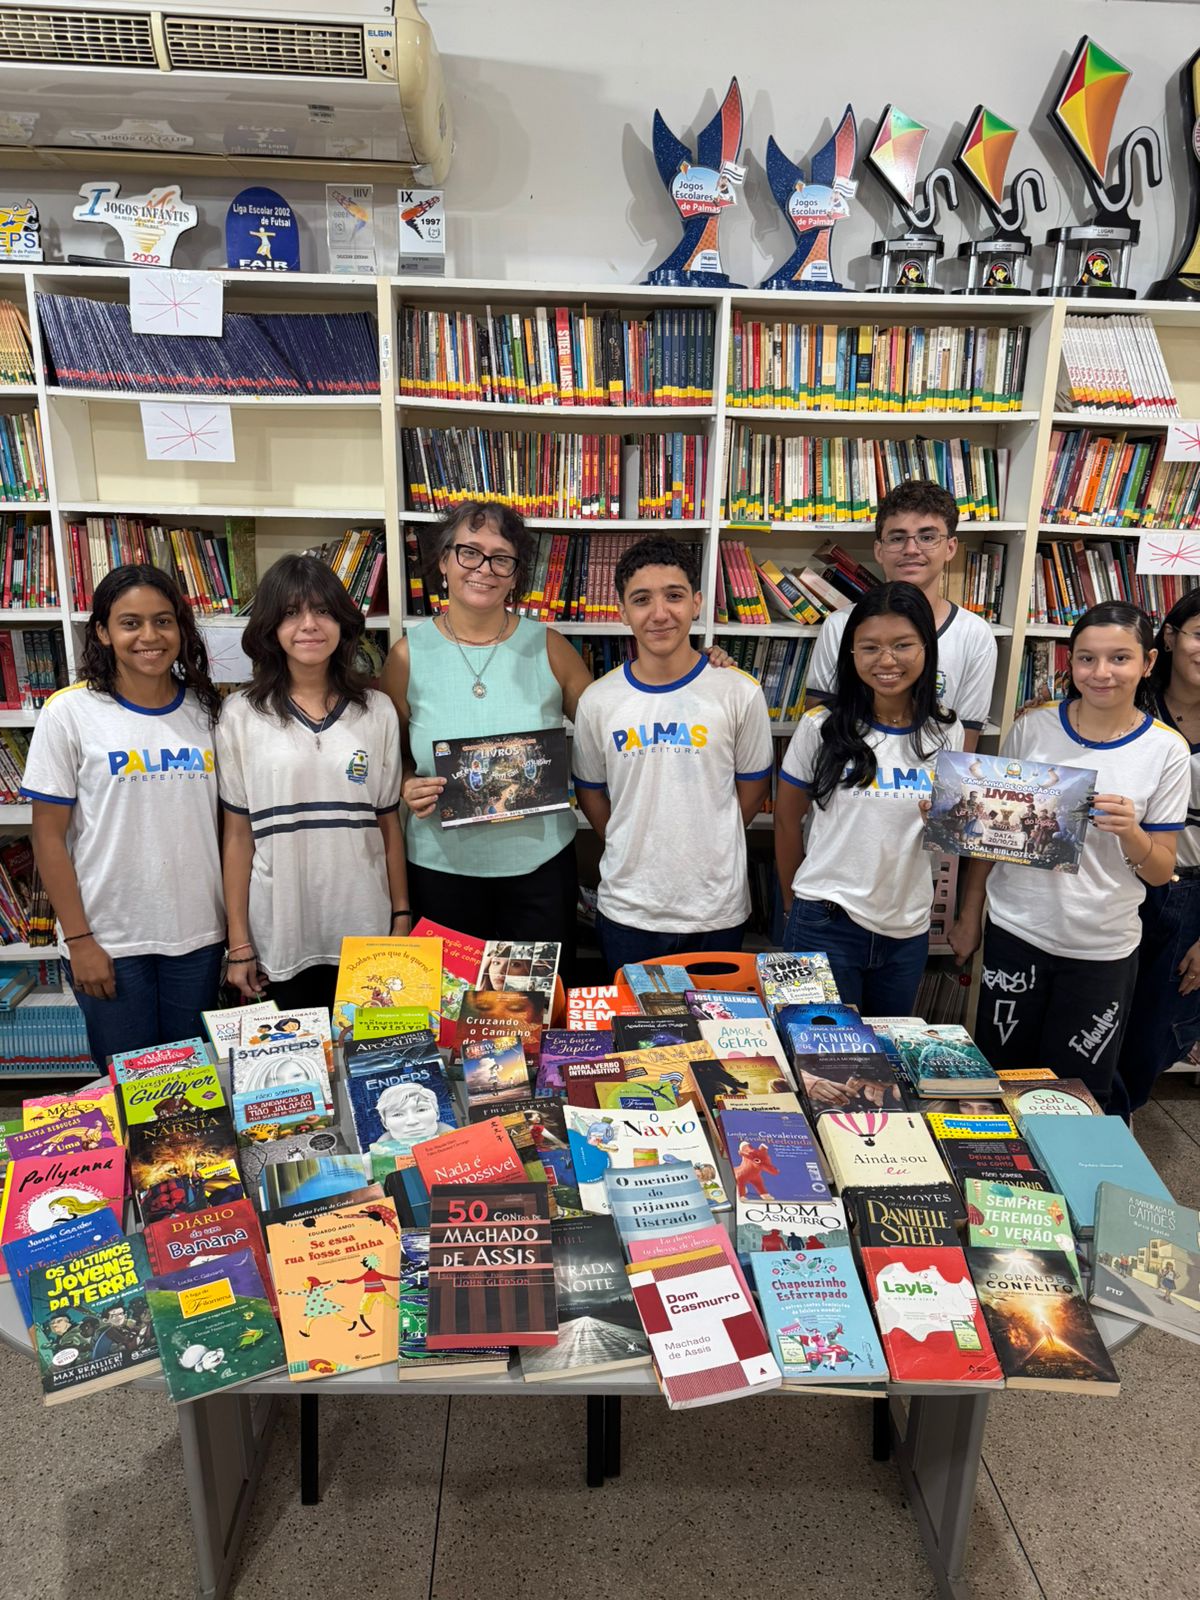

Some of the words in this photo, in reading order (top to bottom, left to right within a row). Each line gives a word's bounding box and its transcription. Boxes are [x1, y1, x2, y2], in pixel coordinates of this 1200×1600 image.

[368, 30, 392, 38] ELGIN
[679, 181, 704, 191] Jogos
[401, 191, 413, 203] IX
[675, 192, 713, 202] Escolares
[795, 199, 818, 209] Jogos
[104, 201, 139, 216] JOGOS
[141, 206, 190, 223] INFANTIS
[233, 204, 247, 215] Liga
[248, 206, 273, 216] Escolar
[274, 207, 291, 217] 2002
[680, 203, 691, 211] de
[692, 203, 721, 213] Palmas
[791, 208, 827, 216] Escolares
[261, 217, 270, 226] de
[270, 217, 291, 228] Futsal
[798, 218, 807, 226] de
[808, 218, 834, 227] Palmas
[132, 252, 161, 264] 2002
[239, 259, 288, 268] FAIR
[557, 330, 570, 356] STIEG
[612, 722, 709, 752] PALMAS
[481, 746, 520, 758] LIVROS
[108, 748, 214, 775] PALMAS
[962, 777, 1004, 788] CAMPANHA
[1005, 782, 1015, 790] DE
[1015, 784, 1048, 795] DOAÇÃO
[1049, 788, 1061, 796] DE
[985, 788, 1034, 804] LIVROS
[993, 832, 1015, 840] DATA:
[963, 843, 991, 853] LOCAL:
[993, 848, 1040, 860] BIBLIOTECA
[426, 929, 434, 937] O
[463, 942, 473, 951] de
[388, 950, 402, 959] que
[461, 955, 481, 966] comp
[766, 959, 801, 972] TOM
[772, 966, 813, 983] GATES
[568, 985, 619, 999] #UM
[569, 999, 611, 1010] DIA
[725, 995, 758, 1004] ALENCAR
[466, 1016, 519, 1027] Cruzando
[569, 1009, 616, 1021] SEM
[482, 1027, 531, 1038] Caminho
[569, 1021, 598, 1031] RE
[721, 1026, 755, 1037] AMOR
[356, 1036, 428, 1052] APOCALIPSE
[552, 1036, 566, 1046] Em
[569, 1036, 597, 1045] busca
[718, 1036, 768, 1049] GELATO
[800, 1033, 808, 1043] O
[813, 1032, 861, 1043] MENINO
[238, 1039, 320, 1060] STARTERS
[594, 1061, 620, 1070] VERBO
[928, 1058, 981, 1067] SELEÇÃO
[569, 1067, 621, 1077] INTRANSITIVO
[365, 1069, 431, 1090] ENDERS
[129, 1075, 216, 1106] Gulliver
[272, 1099, 313, 1113] JALAPÃO
[1032, 1094, 1065, 1105] Sob
[1040, 1102, 1061, 1111] céu
[1063, 1102, 1078, 1111] de
[649, 1113, 659, 1123] O
[47, 1118, 81, 1134] REBOUÇAS
[142, 1117, 220, 1140] NÁRNIA
[621, 1119, 696, 1138] Navio
[758, 1130, 809, 1140] Cavaleiros
[766, 1136, 813, 1146] Redonda
[56, 1141, 81, 1152] Uma
[854, 1153, 898, 1164] Ainda
[900, 1155, 928, 1164] sou
[434, 1162, 471, 1181] Nada
[473, 1155, 481, 1169] é
[886, 1166, 911, 1175] eu
[18, 1159, 114, 1193] Pollyanna
[616, 1176, 629, 1187] O
[634, 1173, 689, 1187] menino
[648, 1188, 663, 1198] do
[900, 1193, 952, 1203] MOYES
[632, 1198, 690, 1215] pijama
[765, 1203, 821, 1217] DOM
[986, 1194, 1046, 1212] SEMPRE
[447, 1200, 489, 1223] 50
[745, 1208, 841, 1229] CASMURRO
[866, 1199, 952, 1229] DANIELLE
[984, 1208, 1053, 1227] TEREMOS
[1128, 1204, 1176, 1231] CAMÕES
[172, 1208, 235, 1233] DIÁRIO
[635, 1211, 697, 1229] listrado
[308, 1226, 337, 1237] EDUARDO
[338, 1223, 356, 1231] AMOS
[880, 1216, 944, 1246] STEEL
[990, 1225, 999, 1237] O
[1004, 1226, 1053, 1243] VERÃO
[167, 1228, 248, 1260] Banana
[310, 1240, 326, 1250] Se
[328, 1235, 356, 1246] essa
[284, 1256, 306, 1265] rua
[308, 1248, 342, 1261] fosse
[345, 1239, 384, 1253] minha
[443, 1251, 465, 1267] DE
[473, 1247, 536, 1266] ASSIS
[45, 1265, 66, 1280] OS
[69, 1242, 131, 1272] ÚLTIMOS
[771, 1276, 847, 1292] Chapeuzinho
[988, 1272, 998, 1282] O
[1003, 1272, 1065, 1284] GRANDE
[49, 1297, 70, 1311] DA
[68, 1269, 139, 1307] TERRA
[556, 1277, 615, 1294] NOITE
[883, 1281, 938, 1297] Layla,
[986, 1280, 1073, 1294] CONFLITO
[665, 1291, 698, 1305] Dom
[776, 1289, 848, 1302] Esfarrapado
[670, 1291, 740, 1316] Casmurro
[664, 1334, 711, 1351] Machado
[668, 1350, 681, 1361] de
[684, 1346, 712, 1359] Assis
[53, 1369, 75, 1382] MAX
